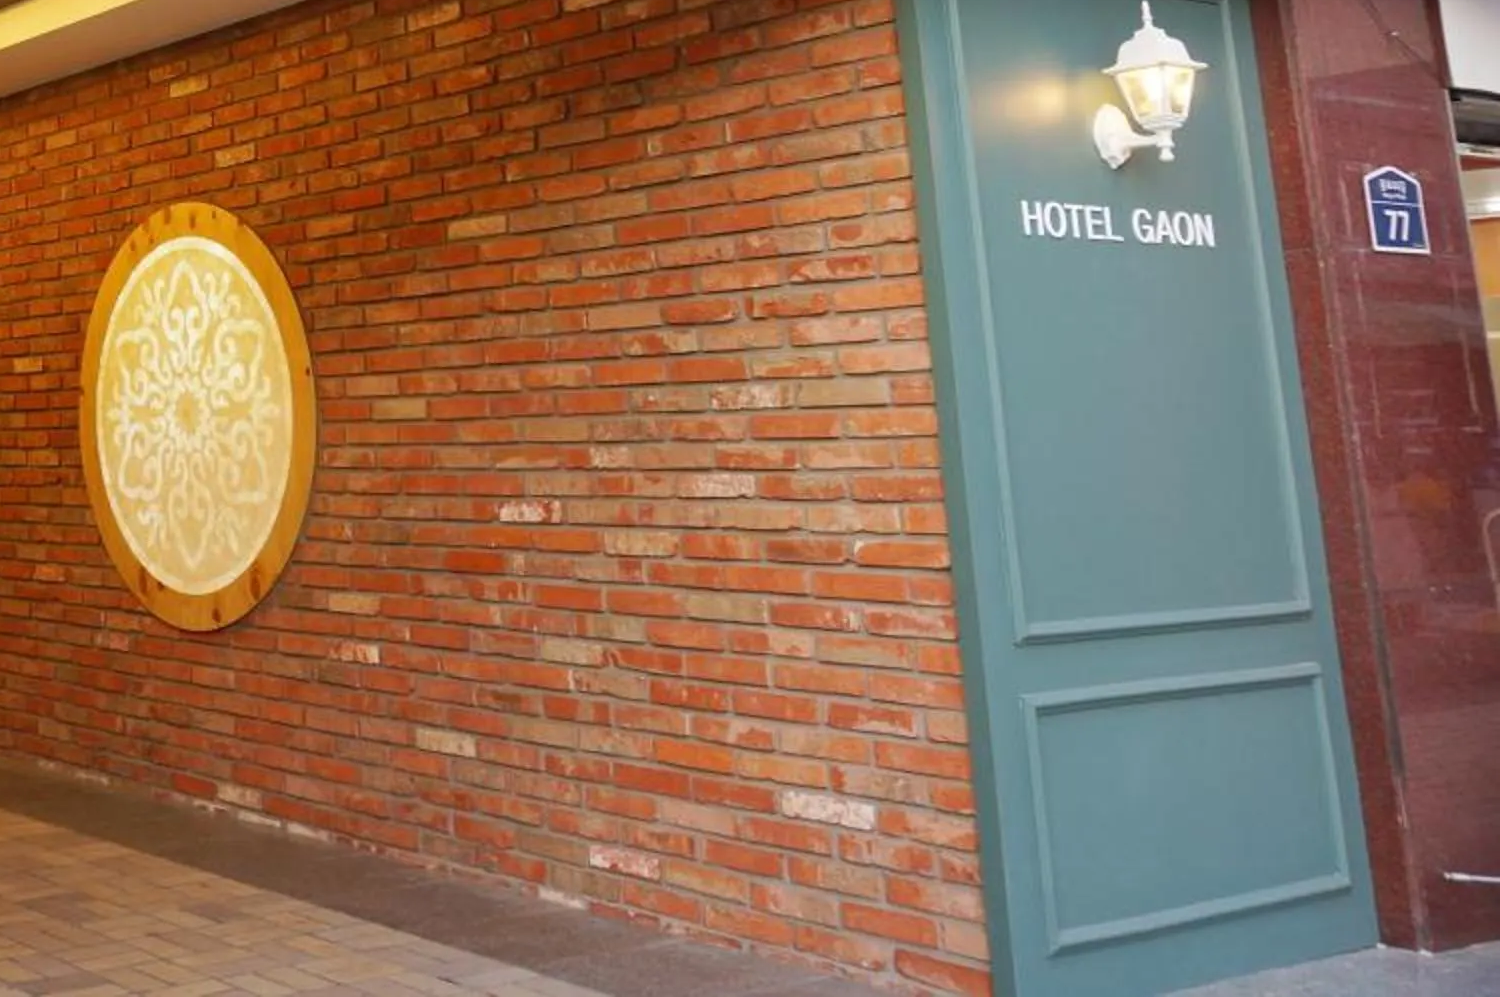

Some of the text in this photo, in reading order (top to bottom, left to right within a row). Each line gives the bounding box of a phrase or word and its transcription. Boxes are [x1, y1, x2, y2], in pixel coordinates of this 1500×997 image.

[1020, 200, 1216, 248] HOTEL GAON
[1383, 208, 1410, 242] 77
